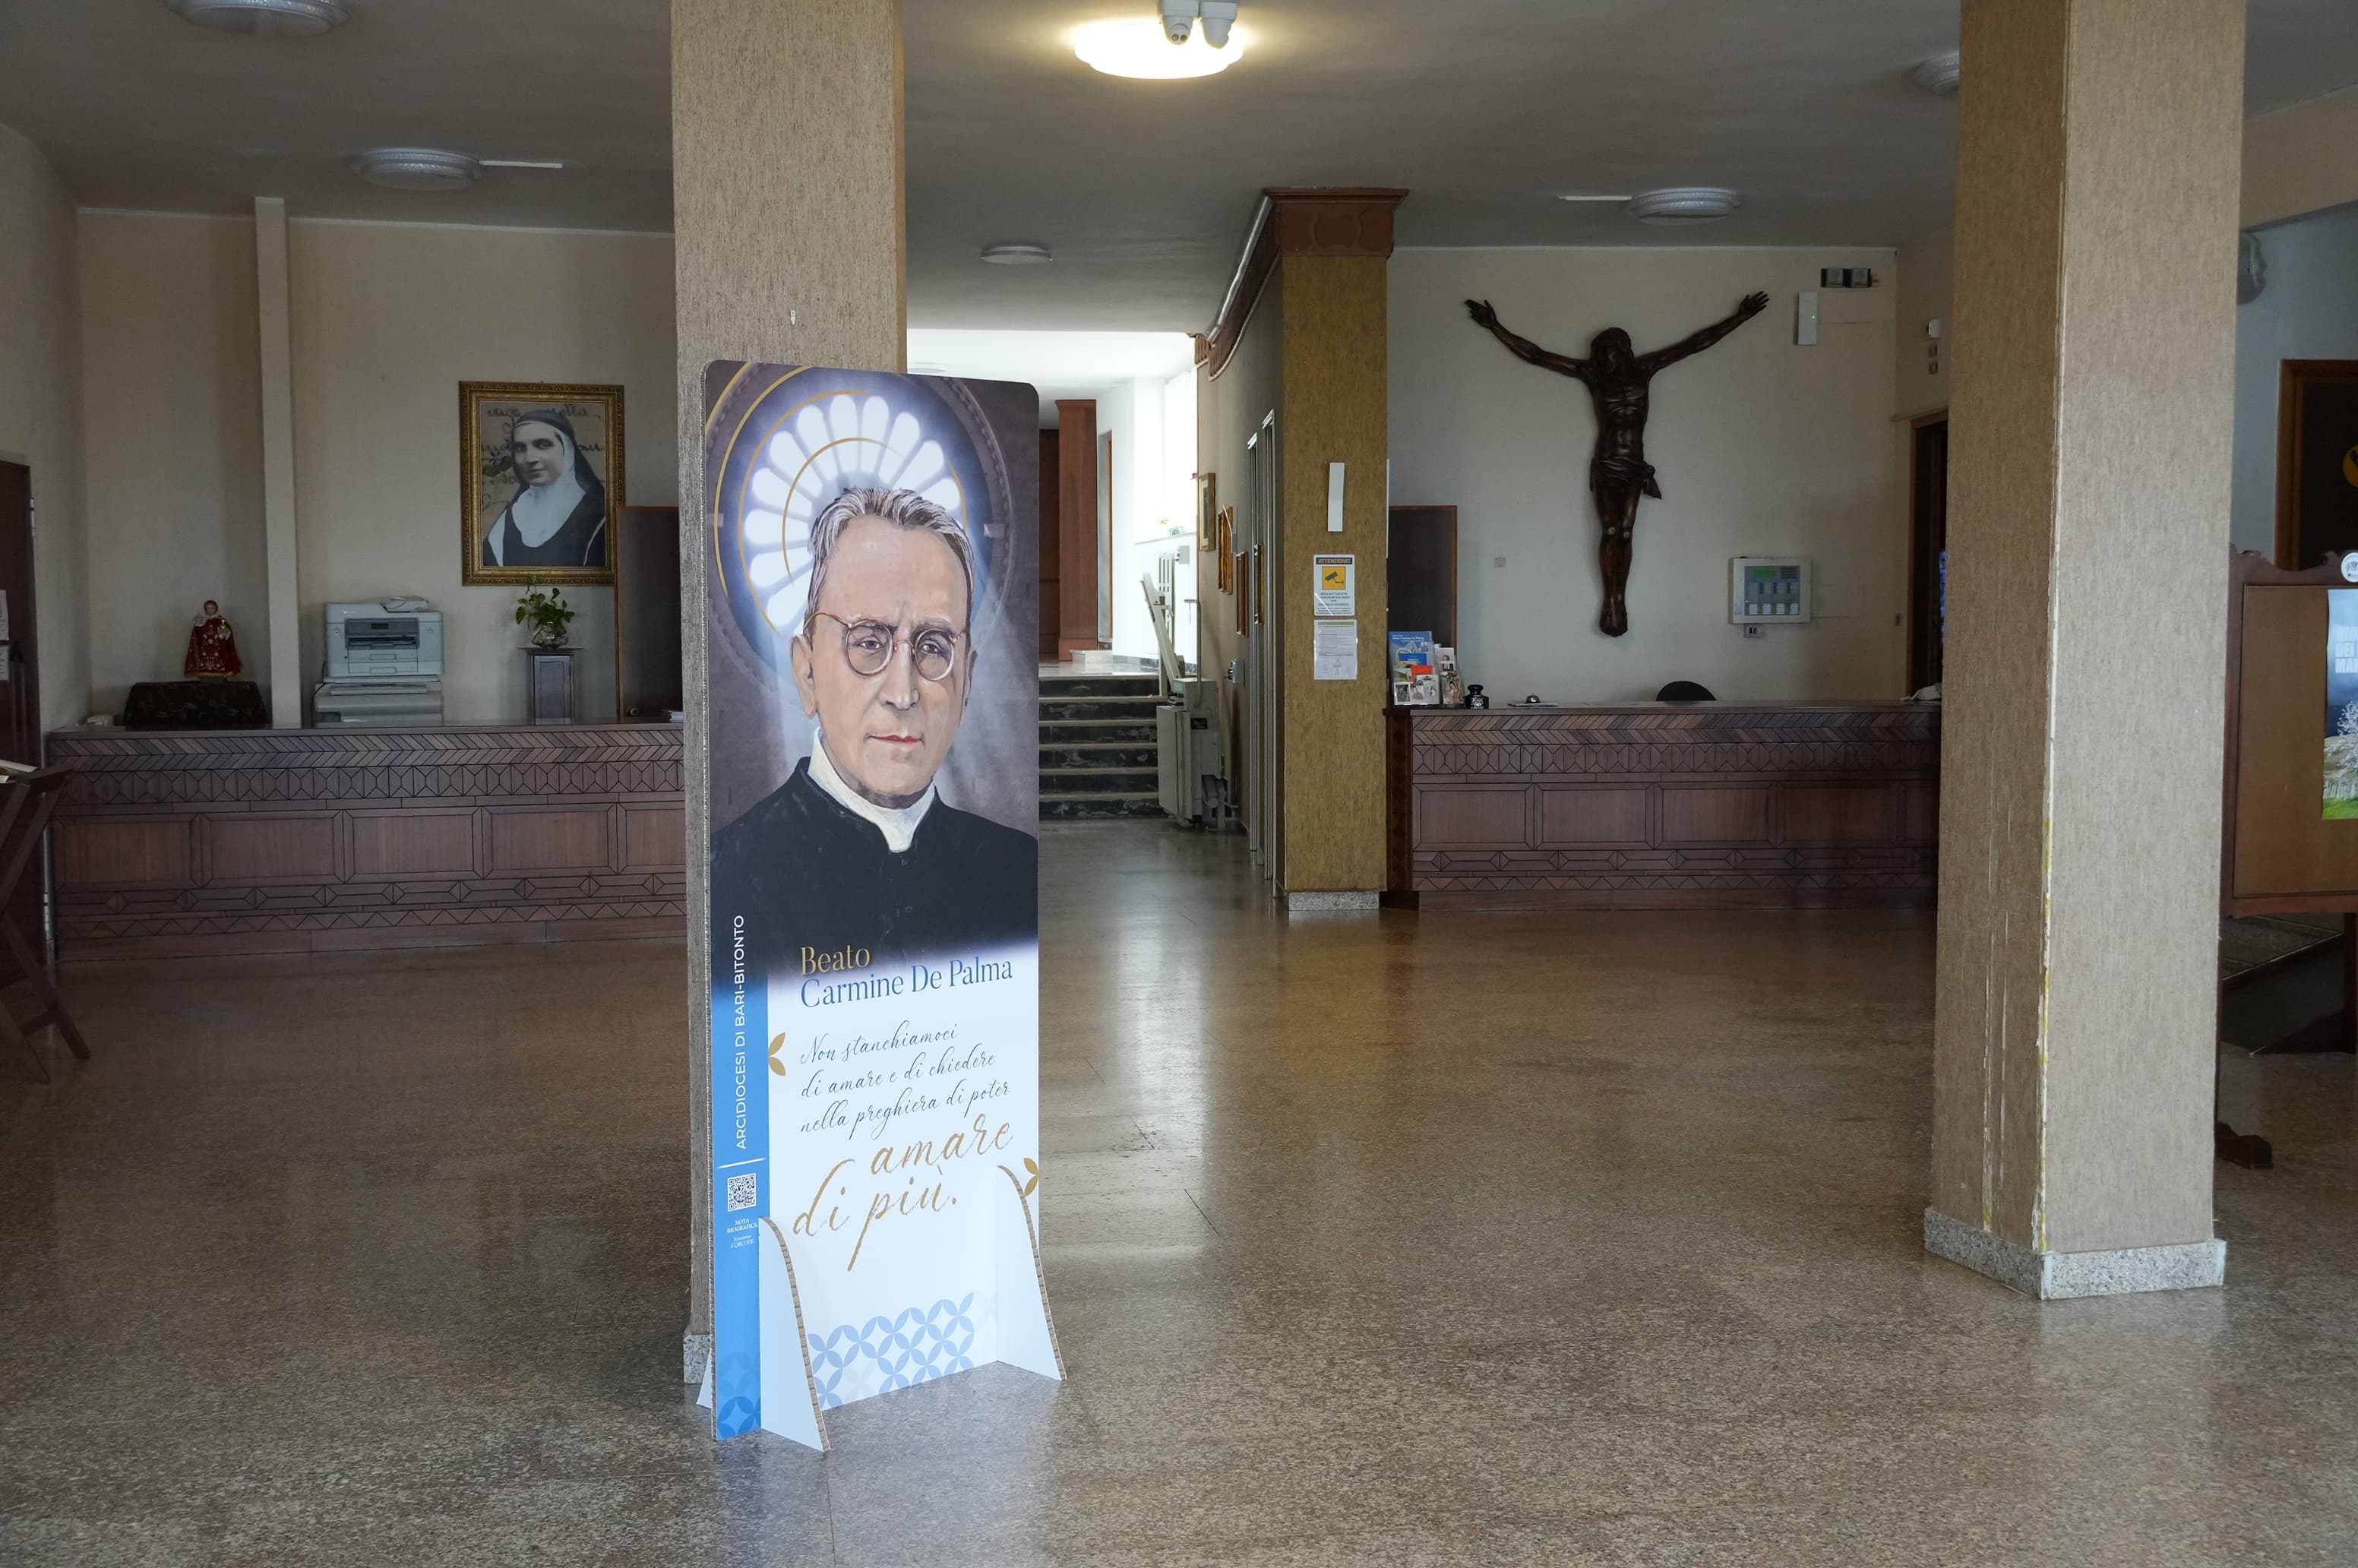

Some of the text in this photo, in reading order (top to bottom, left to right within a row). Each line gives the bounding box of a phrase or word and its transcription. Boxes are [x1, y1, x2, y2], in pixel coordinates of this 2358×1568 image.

[800, 944, 871, 976] Beato
[801, 956, 1013, 1008] Carmine De Palma
[733, 915, 747, 1149] ARCIDIOCESI DI BARI-BITONTO
[800, 1020, 959, 1064] Non stanchiamoci
[801, 1042, 996, 1098] di amare e di chiedere
[800, 1078, 1011, 1141] nella preghiera di poter
[871, 1112, 1014, 1175] amare
[792, 1158, 856, 1238] di
[726, 1223, 757, 1233] BIOGRAFICA
